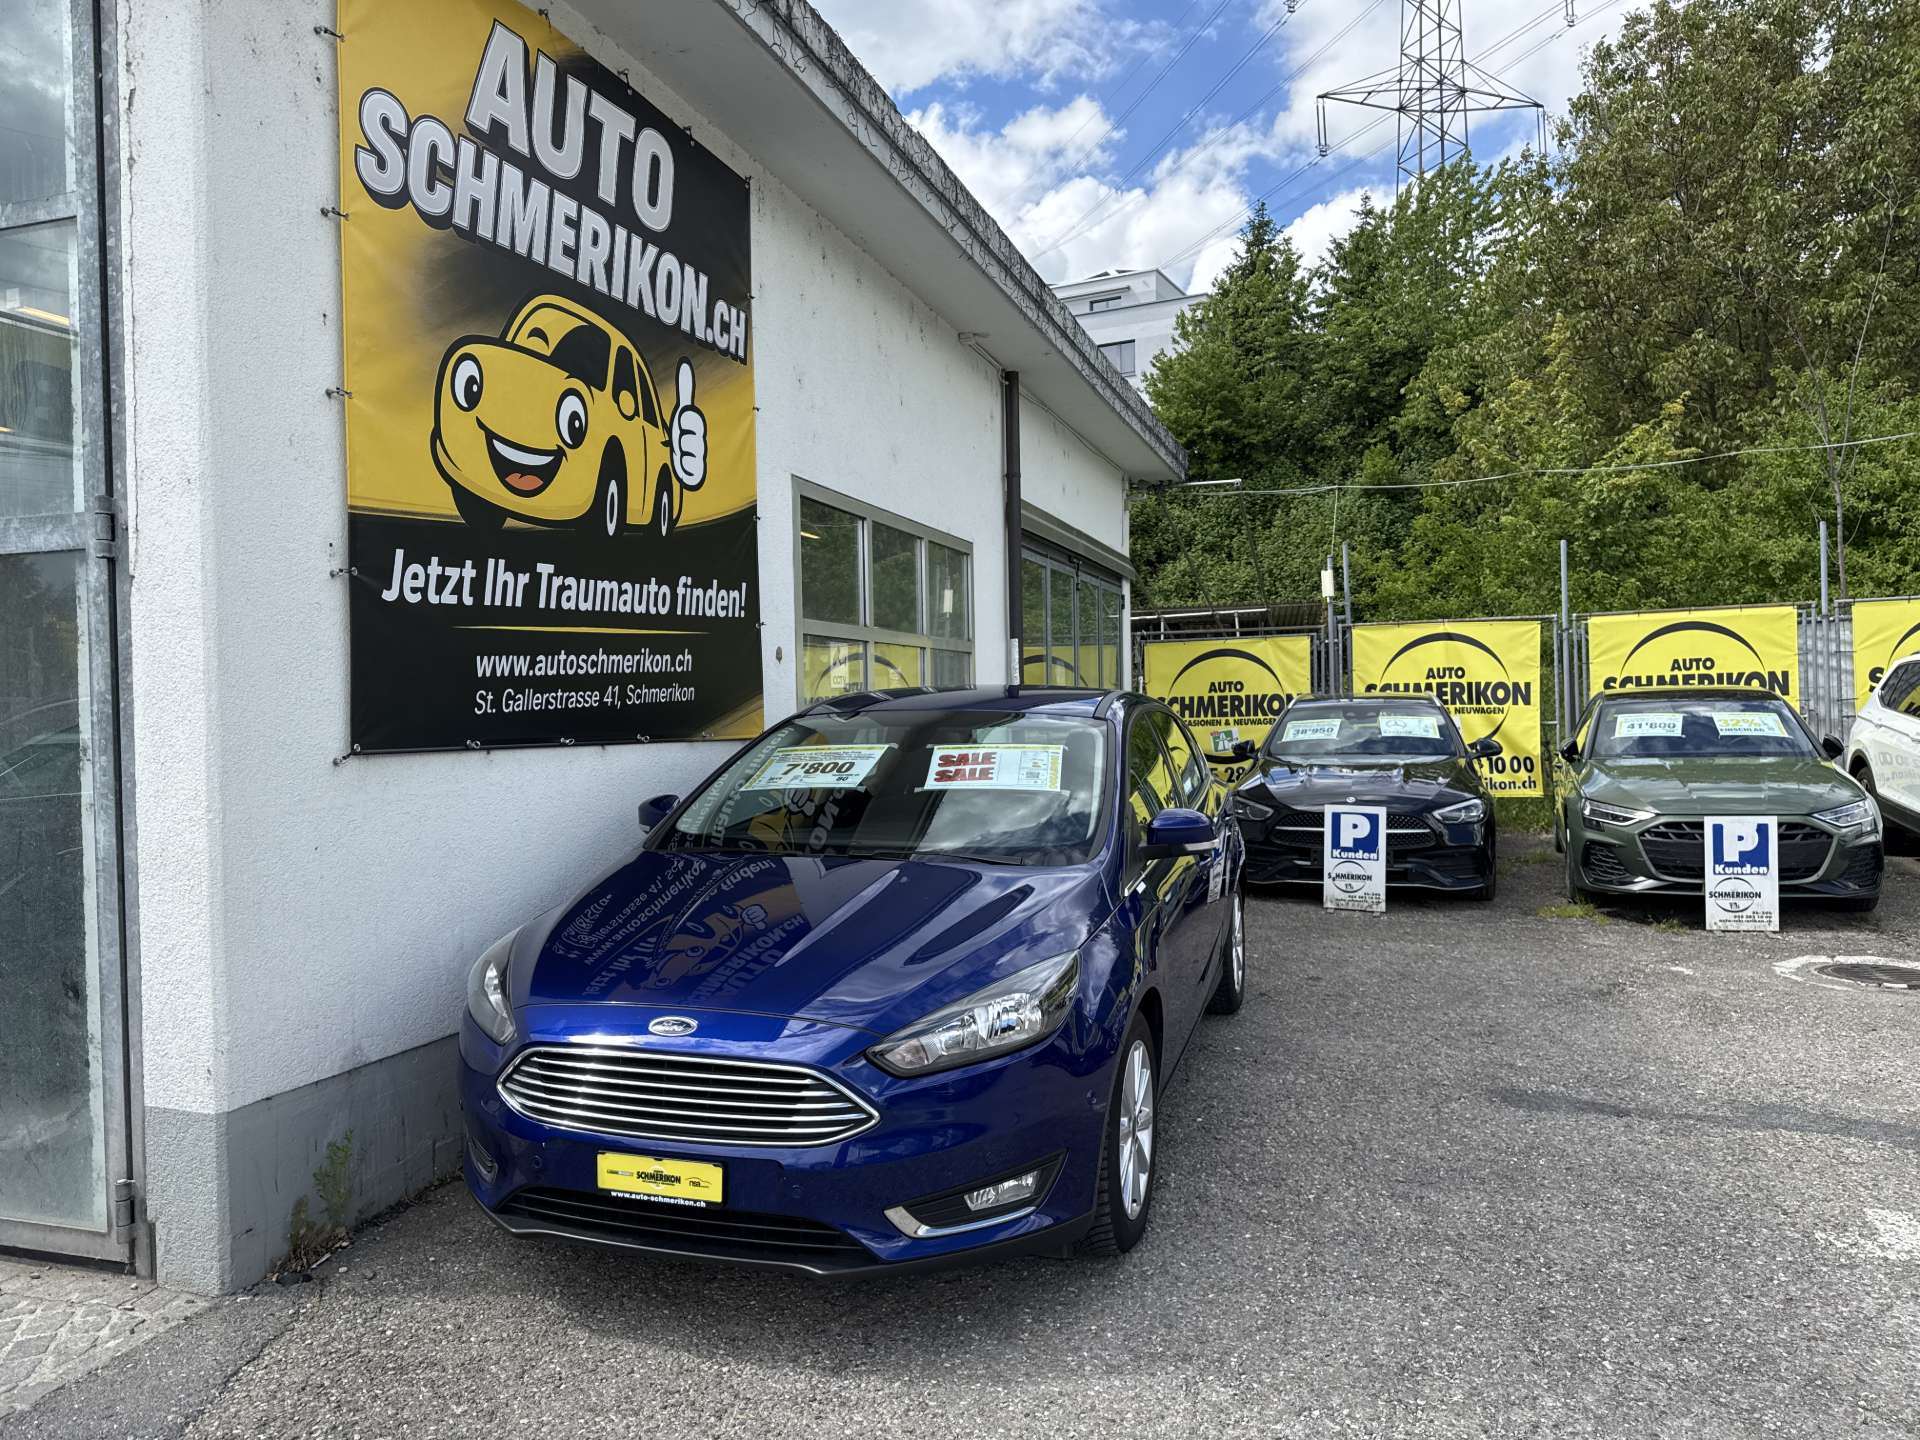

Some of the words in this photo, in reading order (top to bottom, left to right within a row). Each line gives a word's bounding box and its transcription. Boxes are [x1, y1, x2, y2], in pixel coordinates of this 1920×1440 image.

[466, 19, 675, 232] AUTO
[355, 89, 748, 362] SCHMERIKON.CH
[381, 548, 476, 606] Jetzt
[484, 558, 530, 608] Ihr
[536, 562, 671, 615] Traumauto
[676, 575, 747, 618] finden!
[476, 648, 693, 677] www.autoschmerikon.ch
[1670, 657, 1716, 671] AUTO
[1425, 667, 1466, 680] AUTO
[1208, 681, 1244, 693] AUTO
[474, 690, 496, 714] St.
[502, 686, 600, 713] Gallerstrasse
[603, 685, 622, 709] 41,
[626, 682, 695, 706] Schmerikon
[1454, 707, 1504, 715] NEUWAGEN
[1224, 718, 1231, 726] &
[937, 752, 998, 768] SALE
[1488, 756, 1507, 774] 10
[1509, 755, 1535, 774] 00
[781, 761, 856, 776] 7'800
[933, 767, 994, 783] SALE
[1340, 813, 1371, 848] P
[1723, 822, 1759, 862] P
[1332, 849, 1378, 860] Kunden
[1714, 864, 1768, 875] Kunden
[1708, 891, 1762, 900] SCHMERIKON
[636, 1171, 681, 1184] SCHMERIKON
[610, 1191, 706, 1208] www.auto-schmerikon.ch
